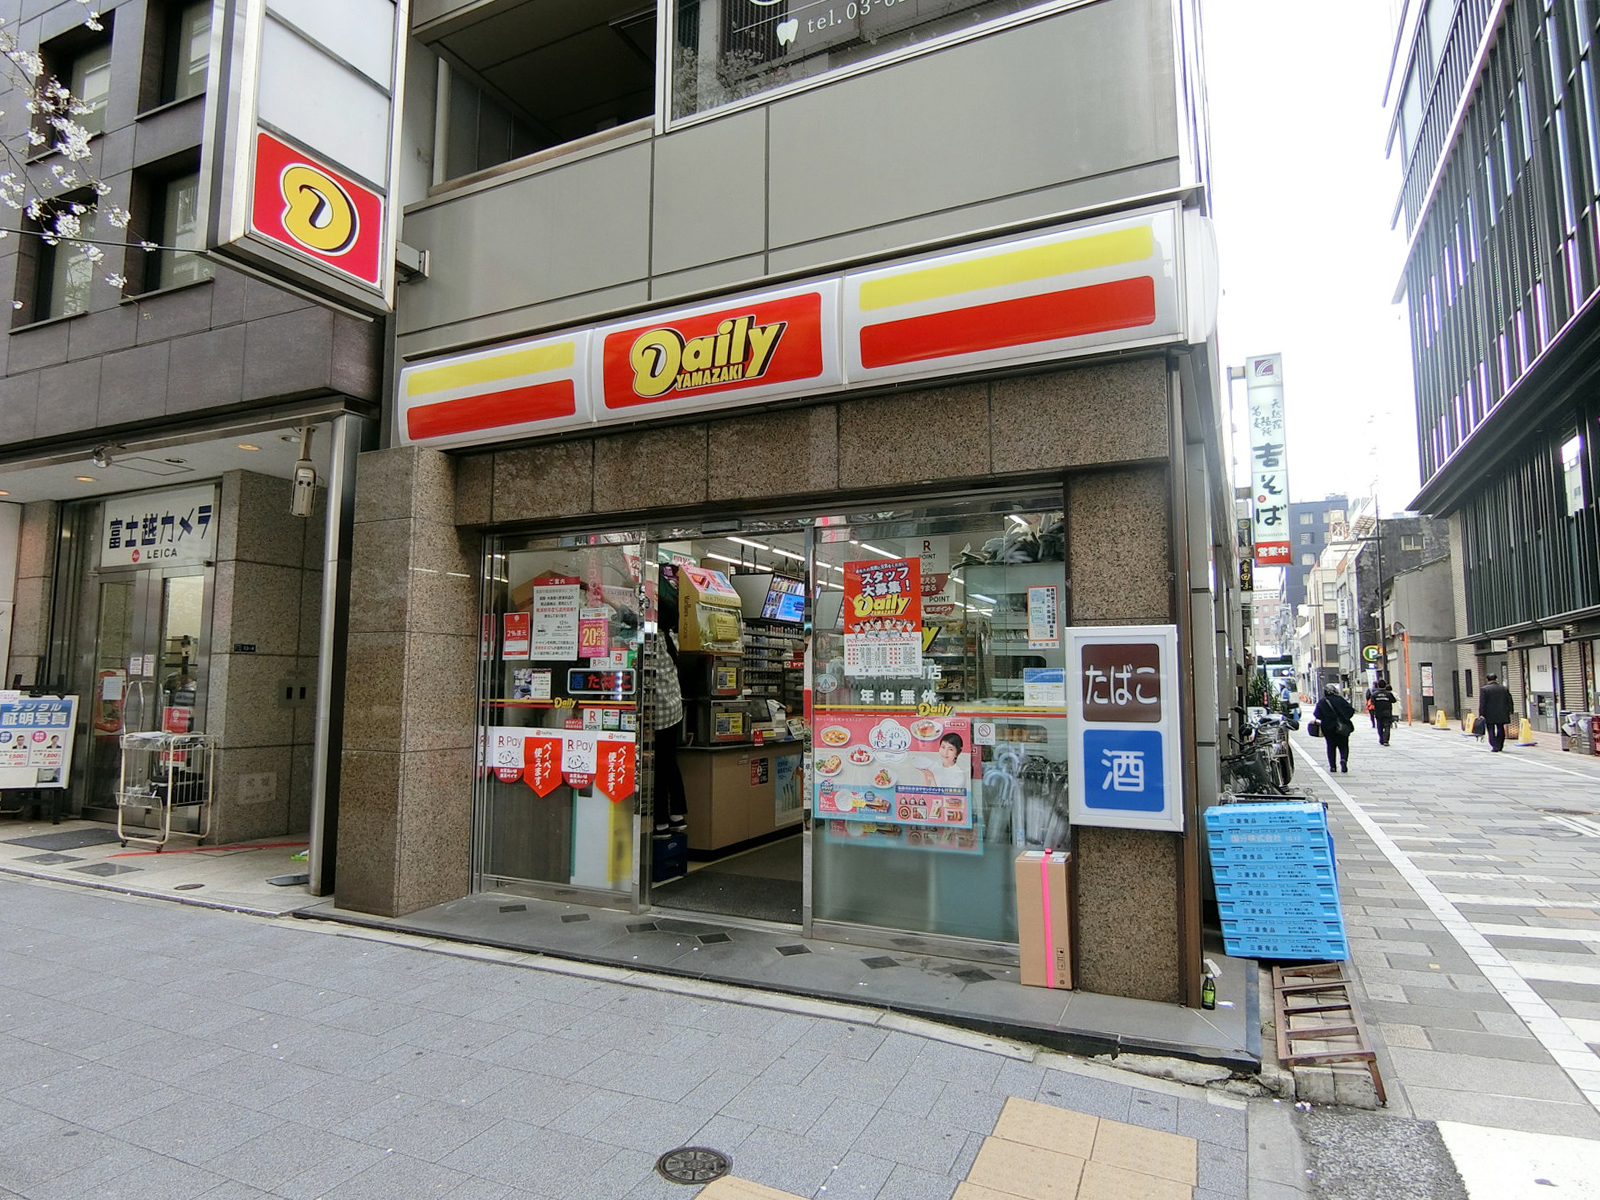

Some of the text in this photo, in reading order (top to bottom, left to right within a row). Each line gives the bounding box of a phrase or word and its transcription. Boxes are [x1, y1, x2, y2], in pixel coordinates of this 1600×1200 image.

[630, 315, 787, 398] Daily
[677, 363, 743, 389] YAMAZAKI
[109, 505, 213, 549] 富士越カメラ
[923, 541, 931, 552] R
[1257, 546, 1289, 558] 営業中
[147, 550, 178, 559] LEICA
[861, 567, 909, 585] スタッフ
[853, 594, 911, 617] Daily
[1368, 648, 1378, 659] P
[588, 674, 631, 689] たばこ
[1085, 664, 1159, 706] たばこ
[554, 698, 579, 709] Daily
[860, 689, 937, 704] 年中無休
[590, 710, 597, 722] R
[918, 702, 954, 717] Daily
[2, 712, 67, 726] 証明写真
[499, 735, 522, 749] R Pay
[568, 739, 594, 753] R Pay
[543, 741, 552, 779] ペイペイ
[617, 746, 627, 785] ペイペイ
[534, 747, 543, 790] 使えます。
[608, 751, 618, 796] 使えます。
[1101, 749, 1145, 793] 酒
